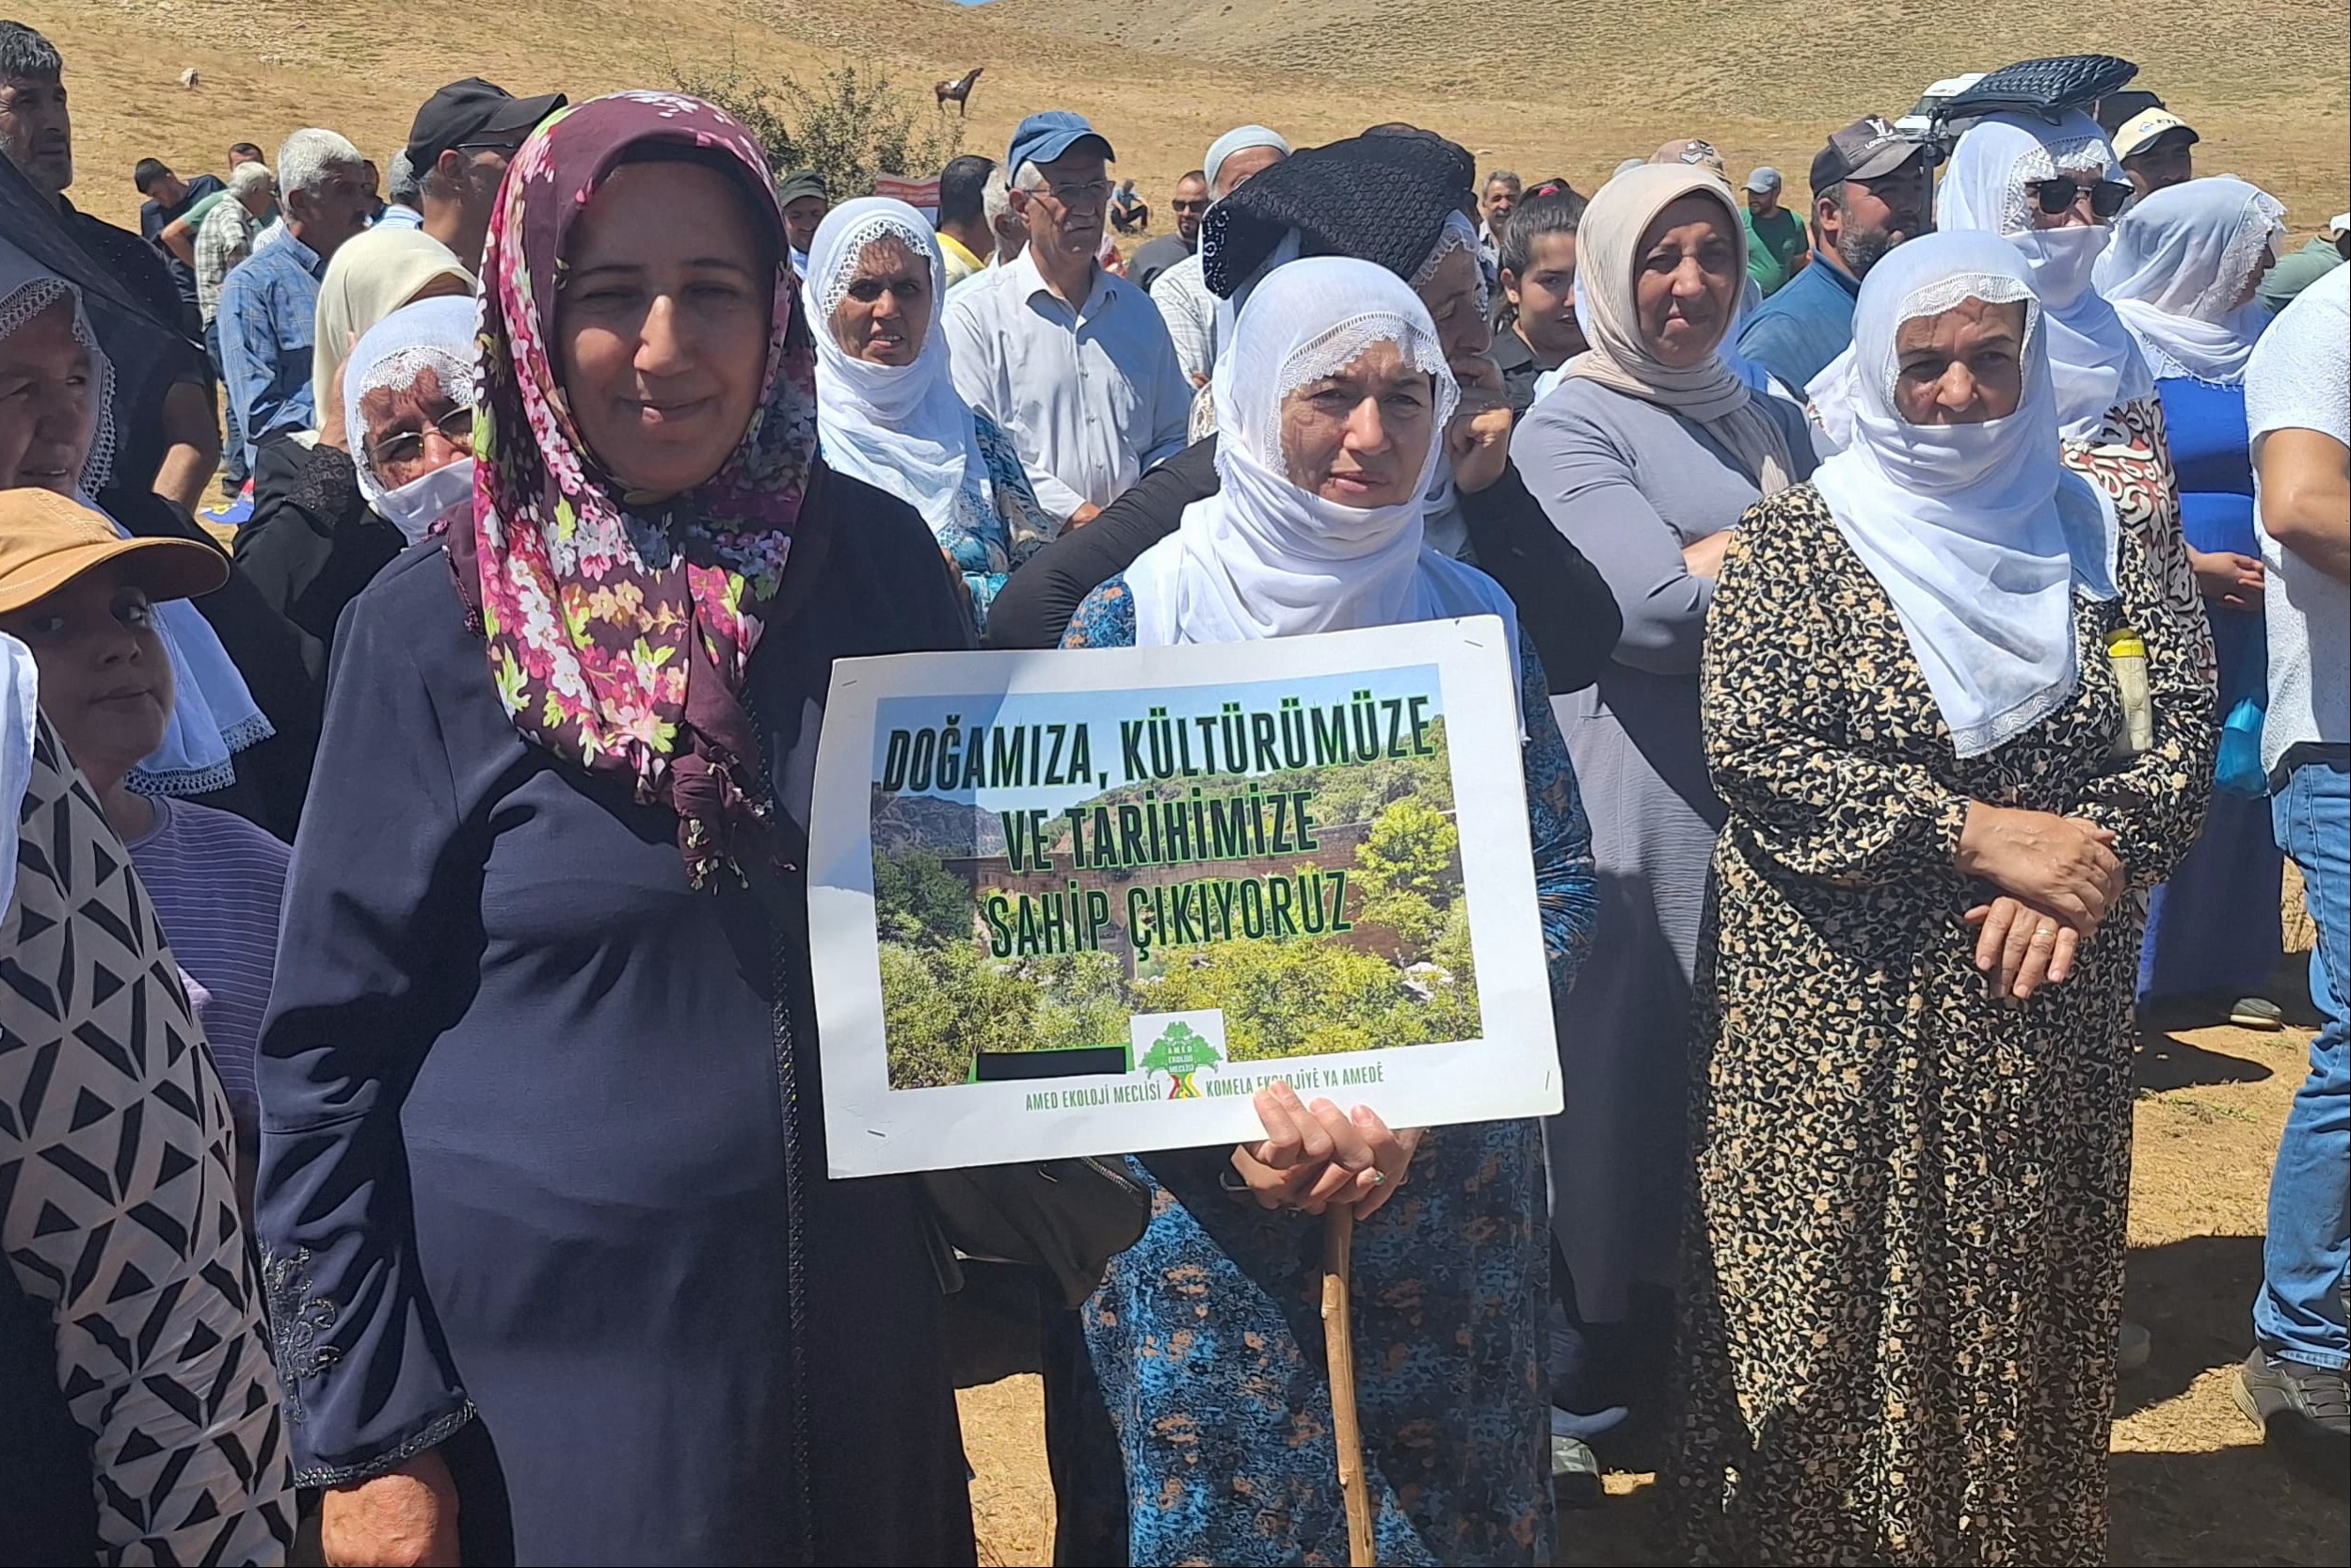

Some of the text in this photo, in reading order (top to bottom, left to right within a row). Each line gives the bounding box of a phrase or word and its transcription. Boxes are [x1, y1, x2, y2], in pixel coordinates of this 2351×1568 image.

[883, 689, 1434, 792] DOĞAMIZA, KÜLTÜRÜMÜZE
[1000, 782, 1319, 872] VE TARİHİMİZE
[986, 870, 1353, 963] SAHİP ÇIKIYORUZ
[1026, 1080, 1161, 1112] AMED EKOLOJİ MECLİSİ
[1206, 1078, 1254, 1097] KOMELA
[1323, 1069, 1338, 1087] YA
